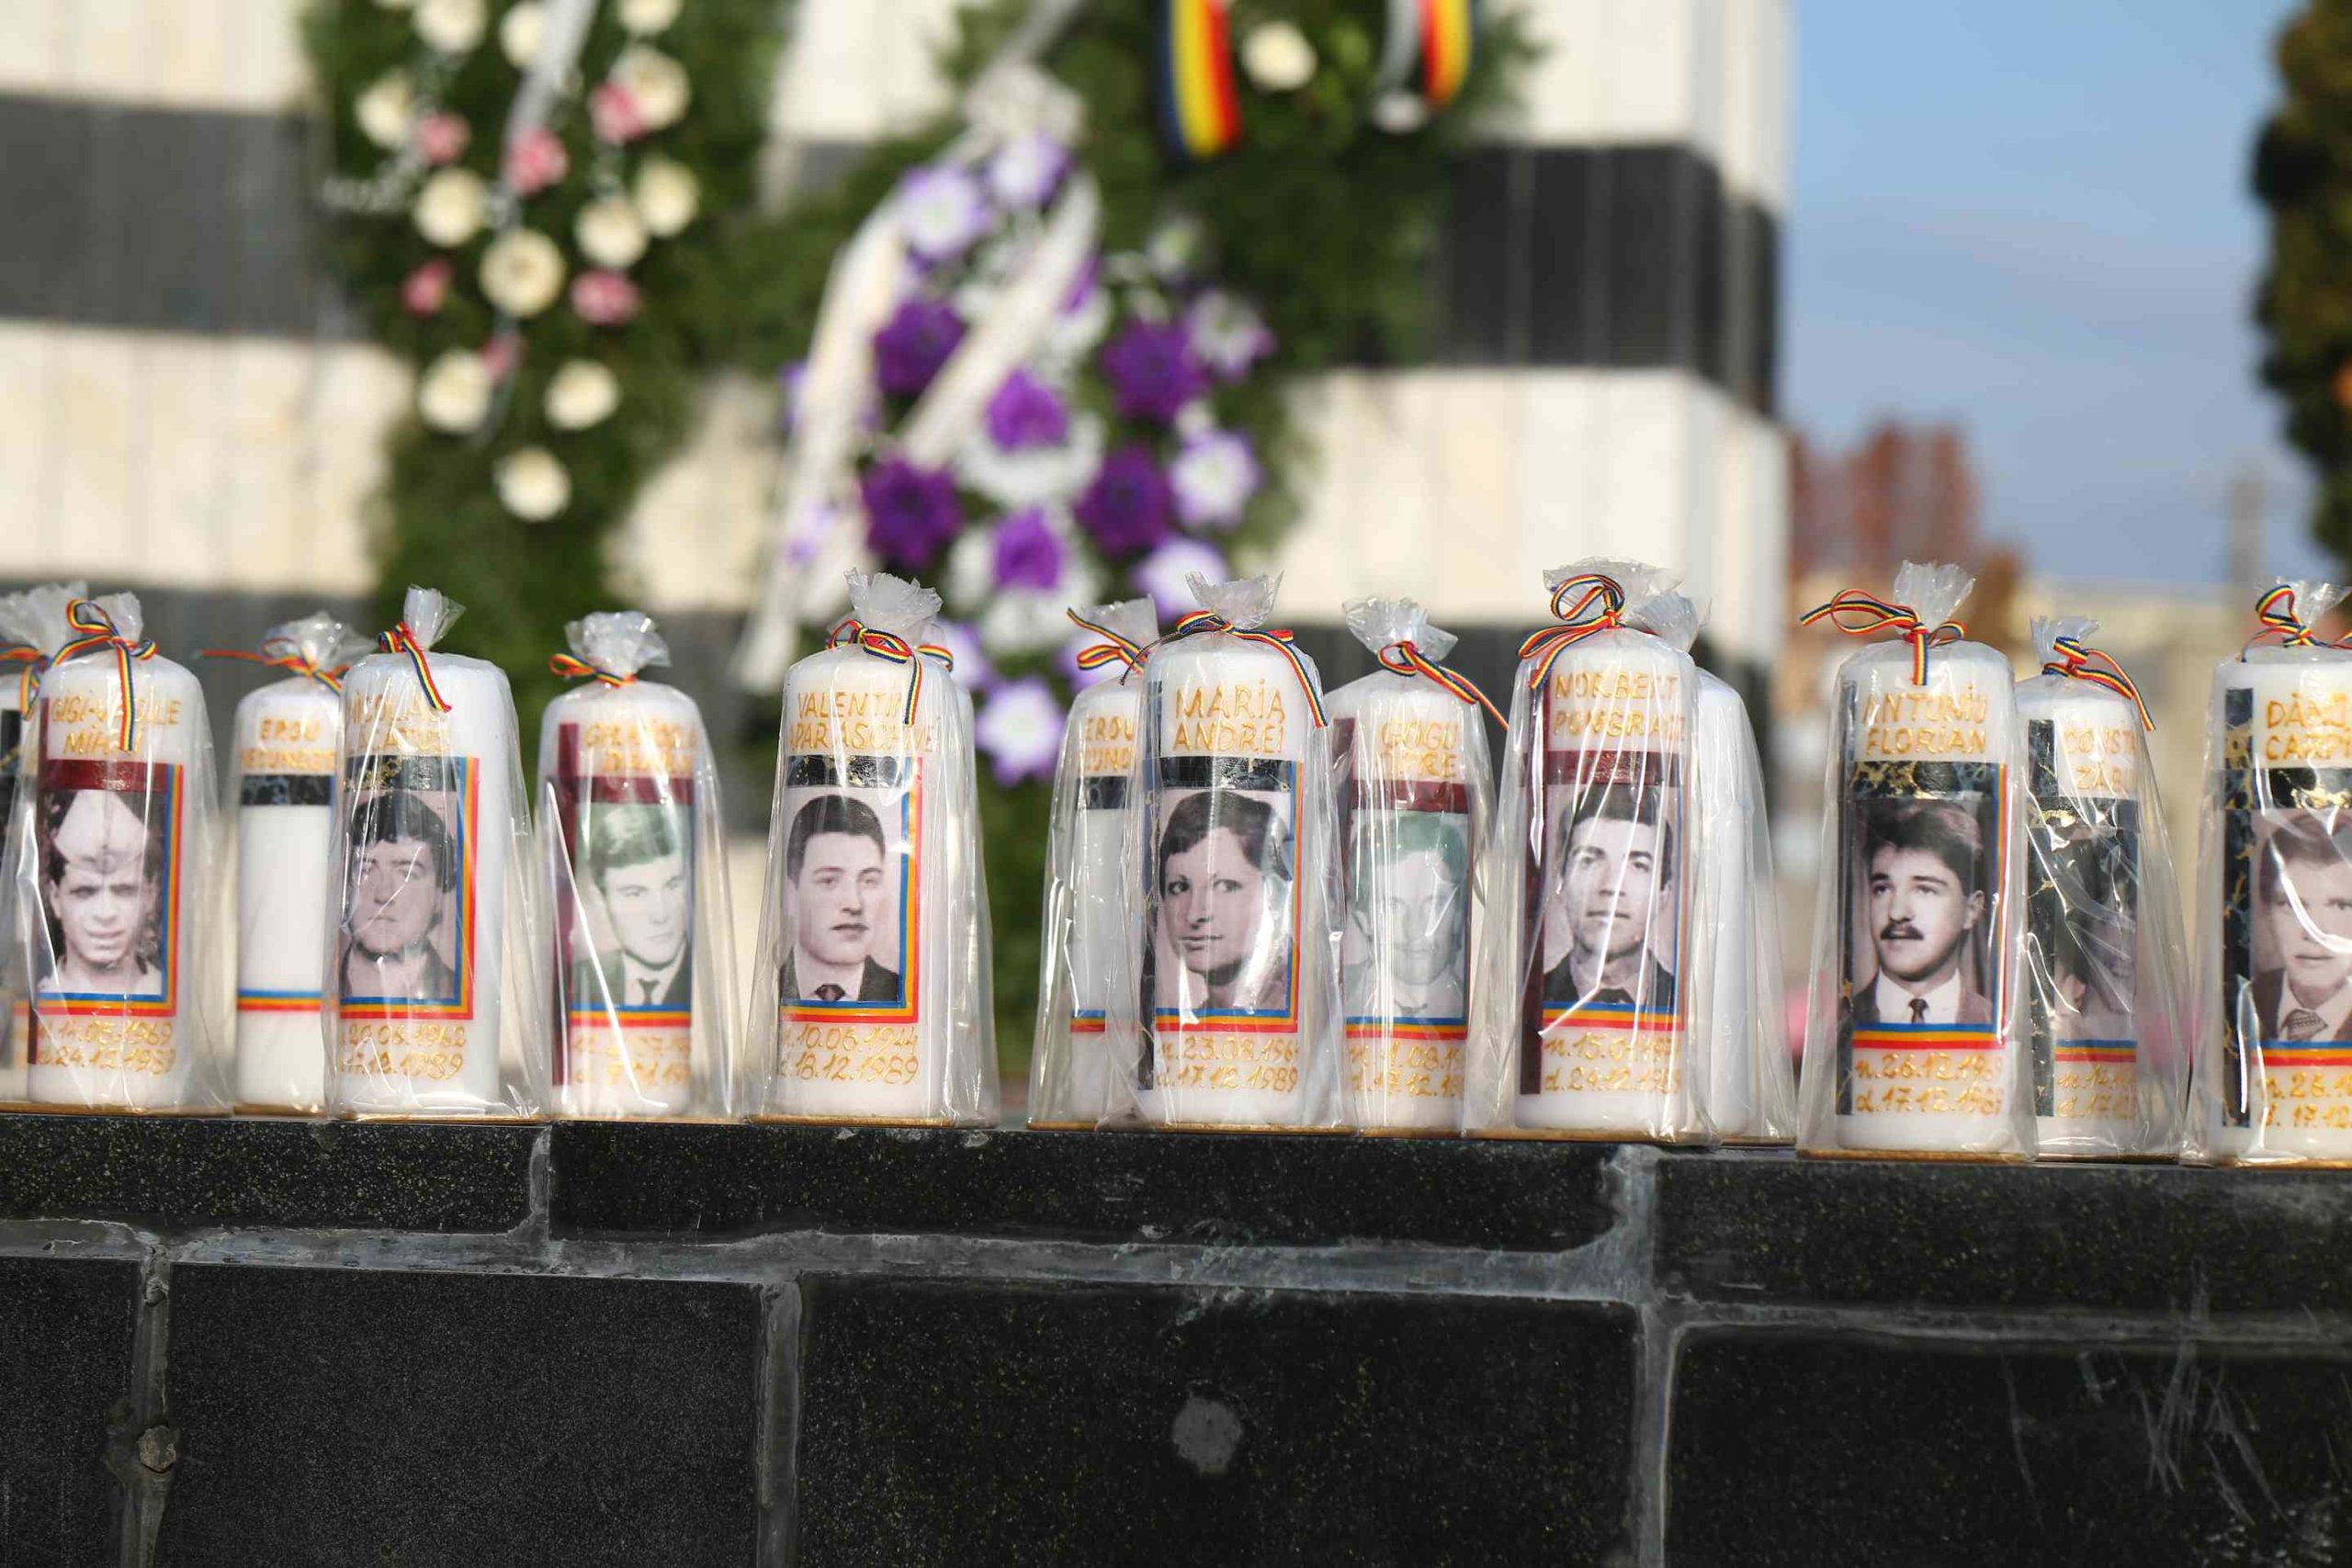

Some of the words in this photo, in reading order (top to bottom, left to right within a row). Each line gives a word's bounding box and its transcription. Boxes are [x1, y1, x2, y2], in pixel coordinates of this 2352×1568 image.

[797, 691, 902, 718] VALENTIN
[1175, 679, 1285, 723] MARIA
[1172, 721, 1284, 753] ANDREI
[1865, 726, 1986, 756] FLORIAN
[795, 1051, 919, 1085] 18.12.1989
